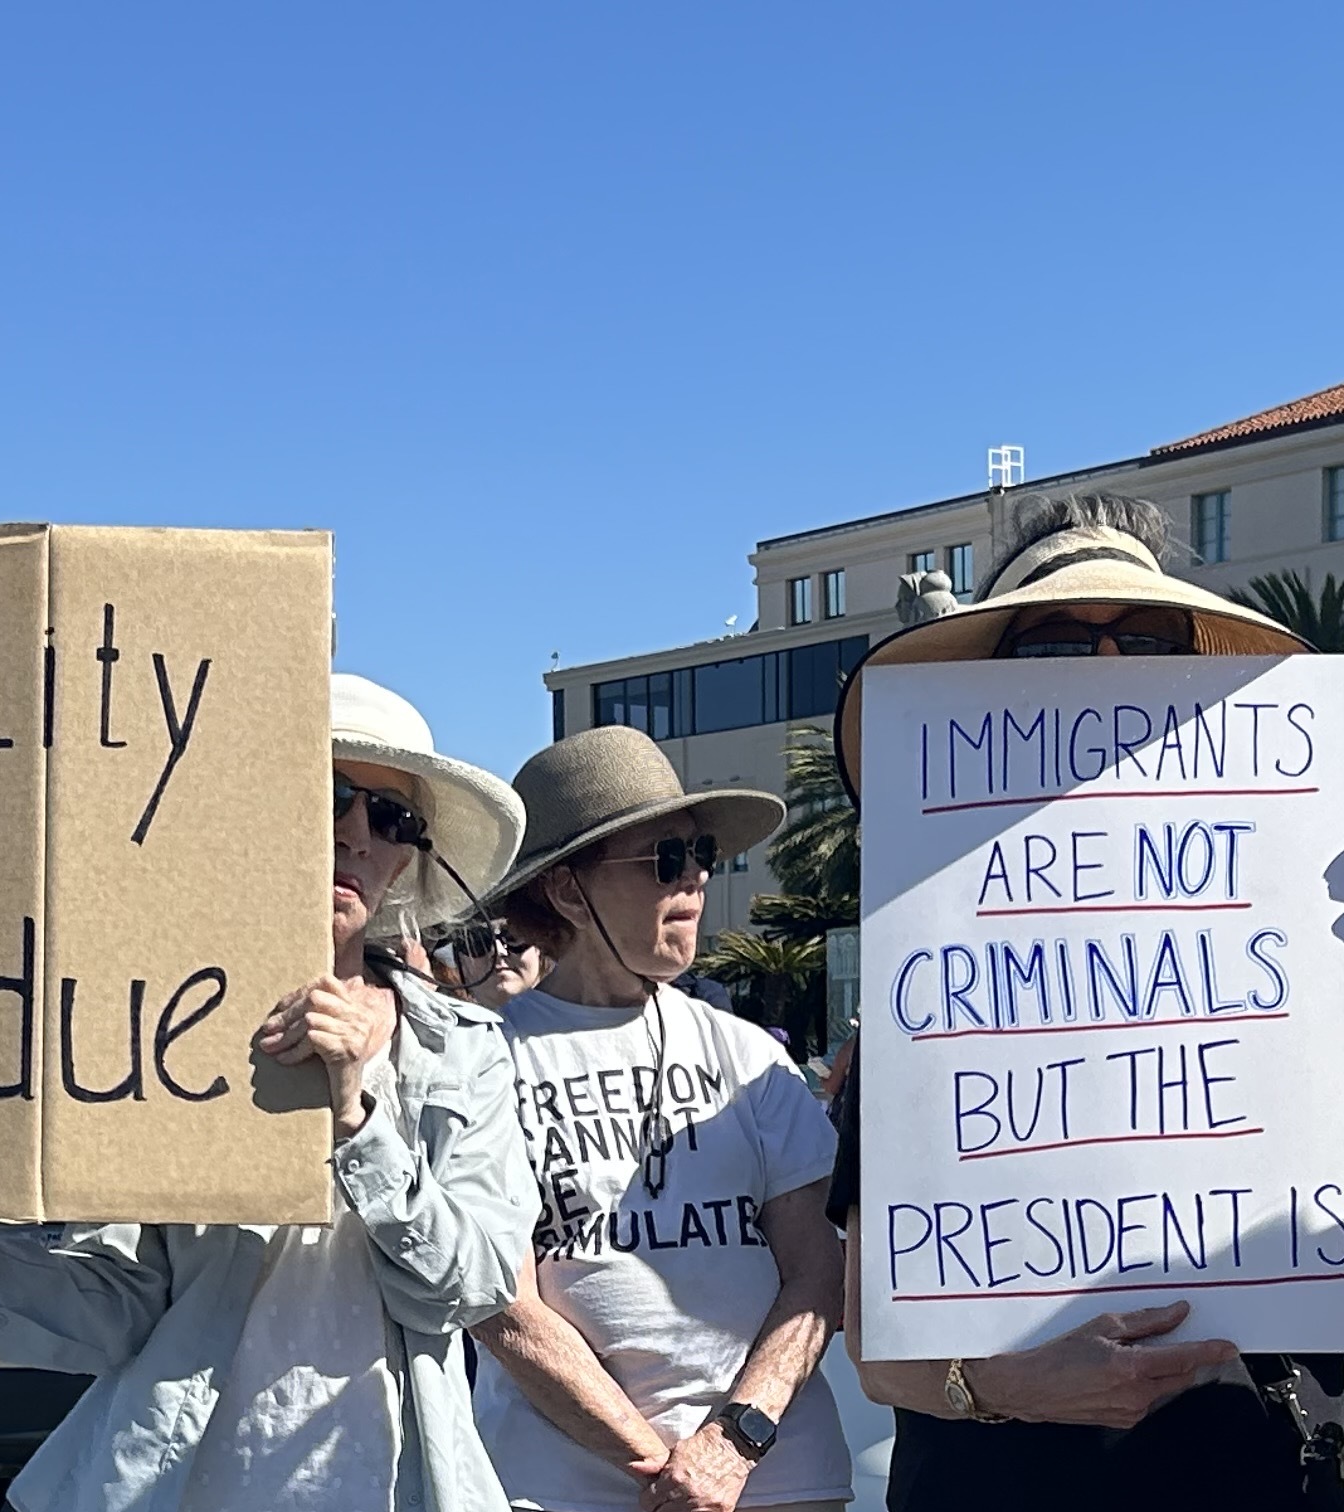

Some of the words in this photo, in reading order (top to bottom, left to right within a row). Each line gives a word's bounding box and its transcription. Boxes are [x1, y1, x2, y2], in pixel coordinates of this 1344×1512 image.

[921, 701, 1316, 799] IMMIGRANTS
[977, 831, 1115, 905] ARE
[1134, 820, 1256, 902] NOT
[890, 928, 1289, 1036] CRIMINALS
[523, 1106, 701, 1173] ANNT
[955, 1057, 1085, 1153] BUT
[1106, 1040, 1247, 1135] THE
[531, 1194, 769, 1267] SIMULATE
[887, 1188, 1253, 1290] PRESIDENT
